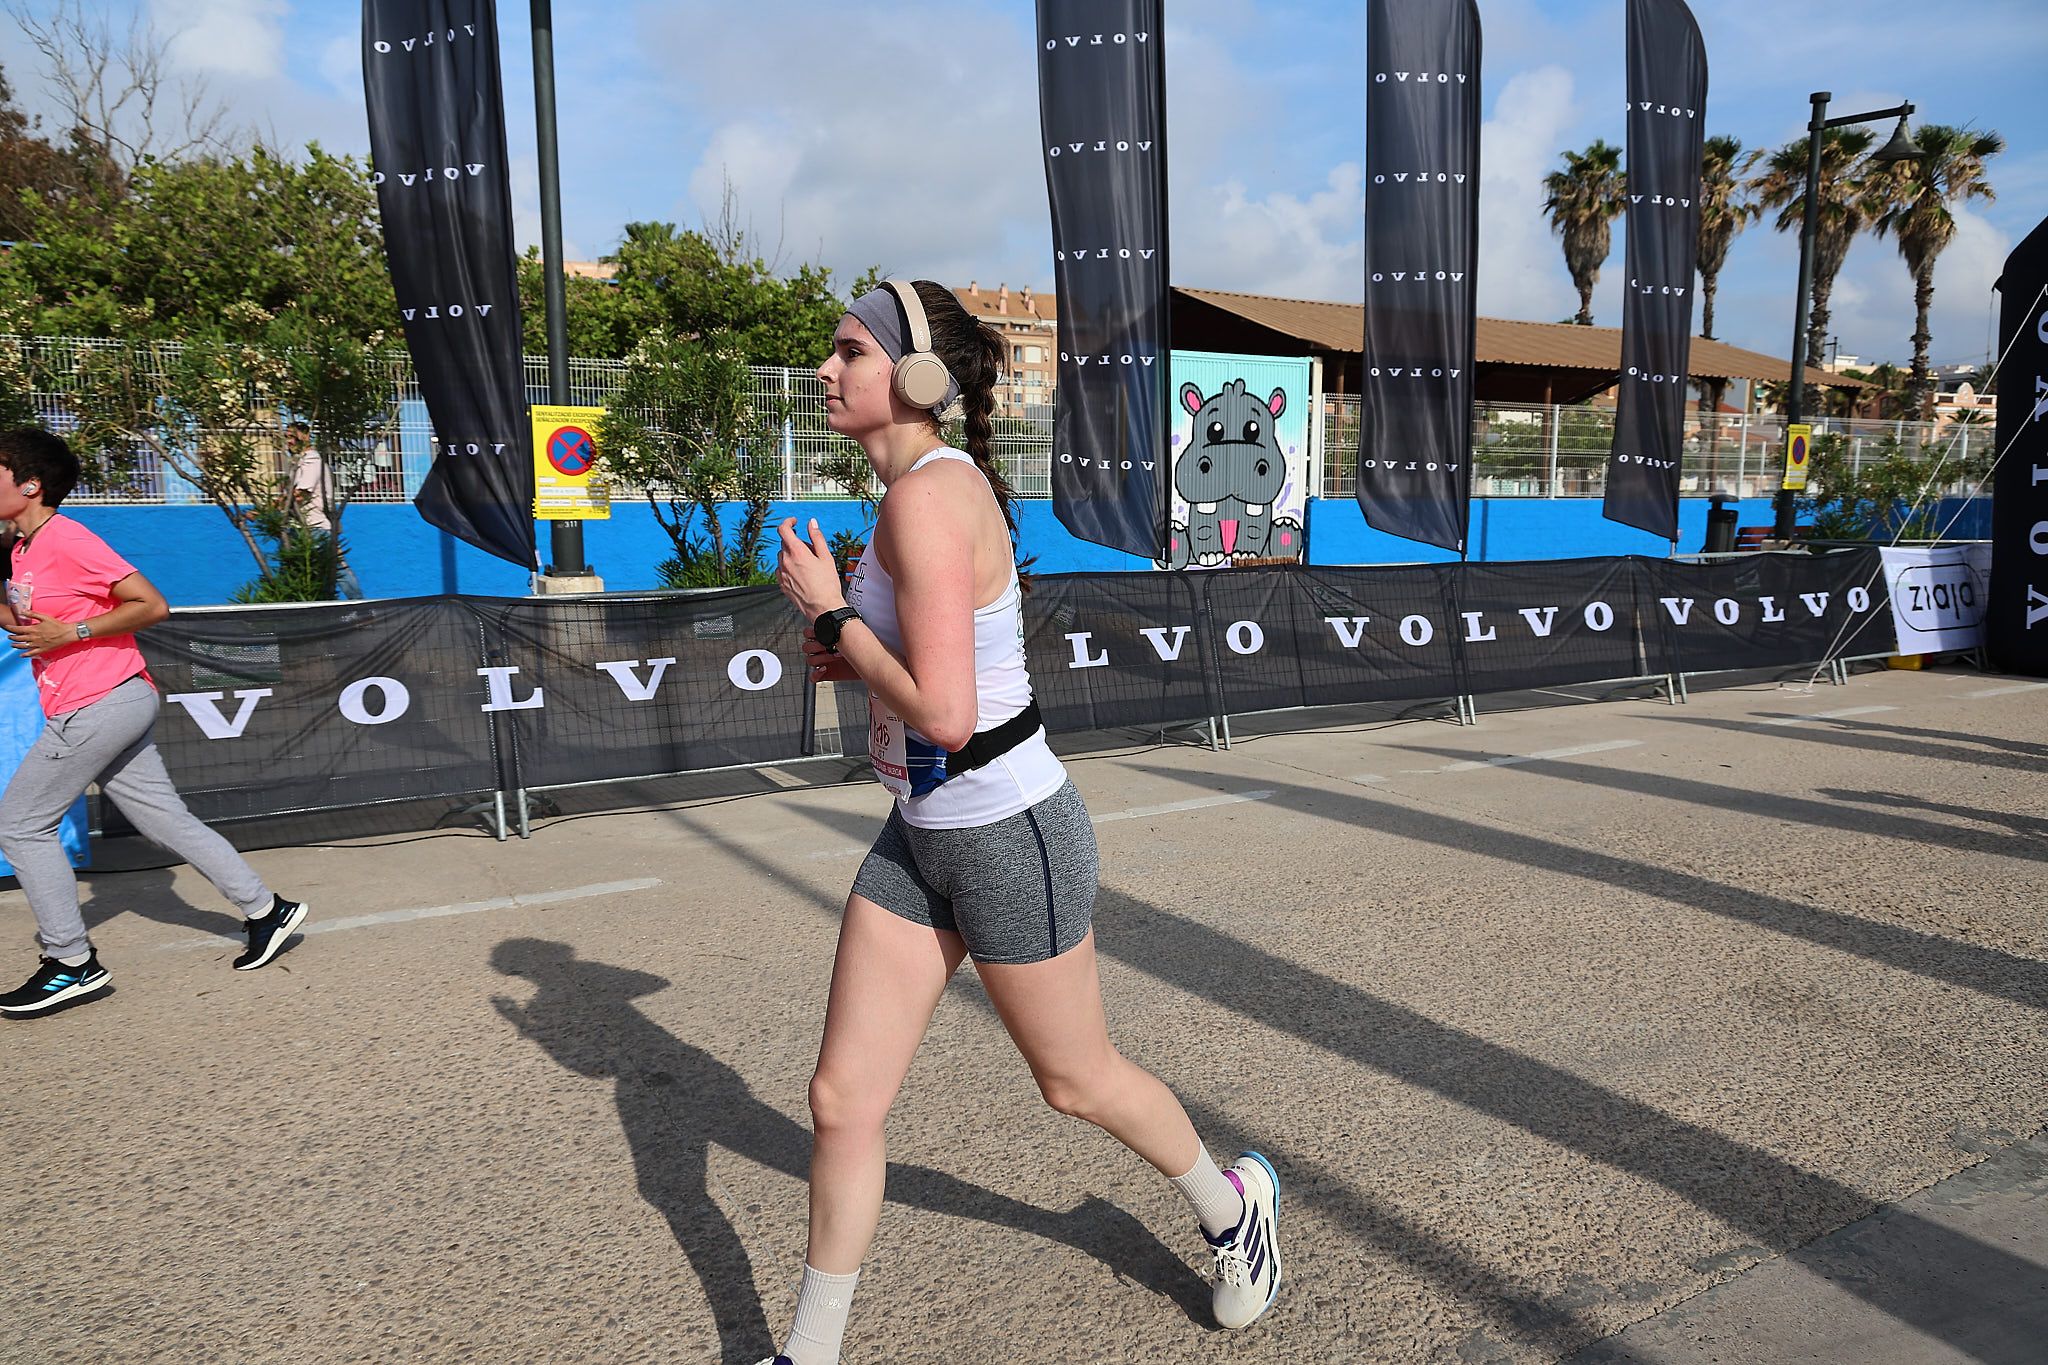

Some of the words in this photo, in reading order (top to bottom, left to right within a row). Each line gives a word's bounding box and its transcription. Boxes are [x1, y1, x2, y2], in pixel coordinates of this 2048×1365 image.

[167, 649, 782, 739] VOLVO
[1064, 620, 1265, 669] LVO
[1324, 601, 1614, 647] VOLVO
[1660, 586, 1870, 626] VOLVO
